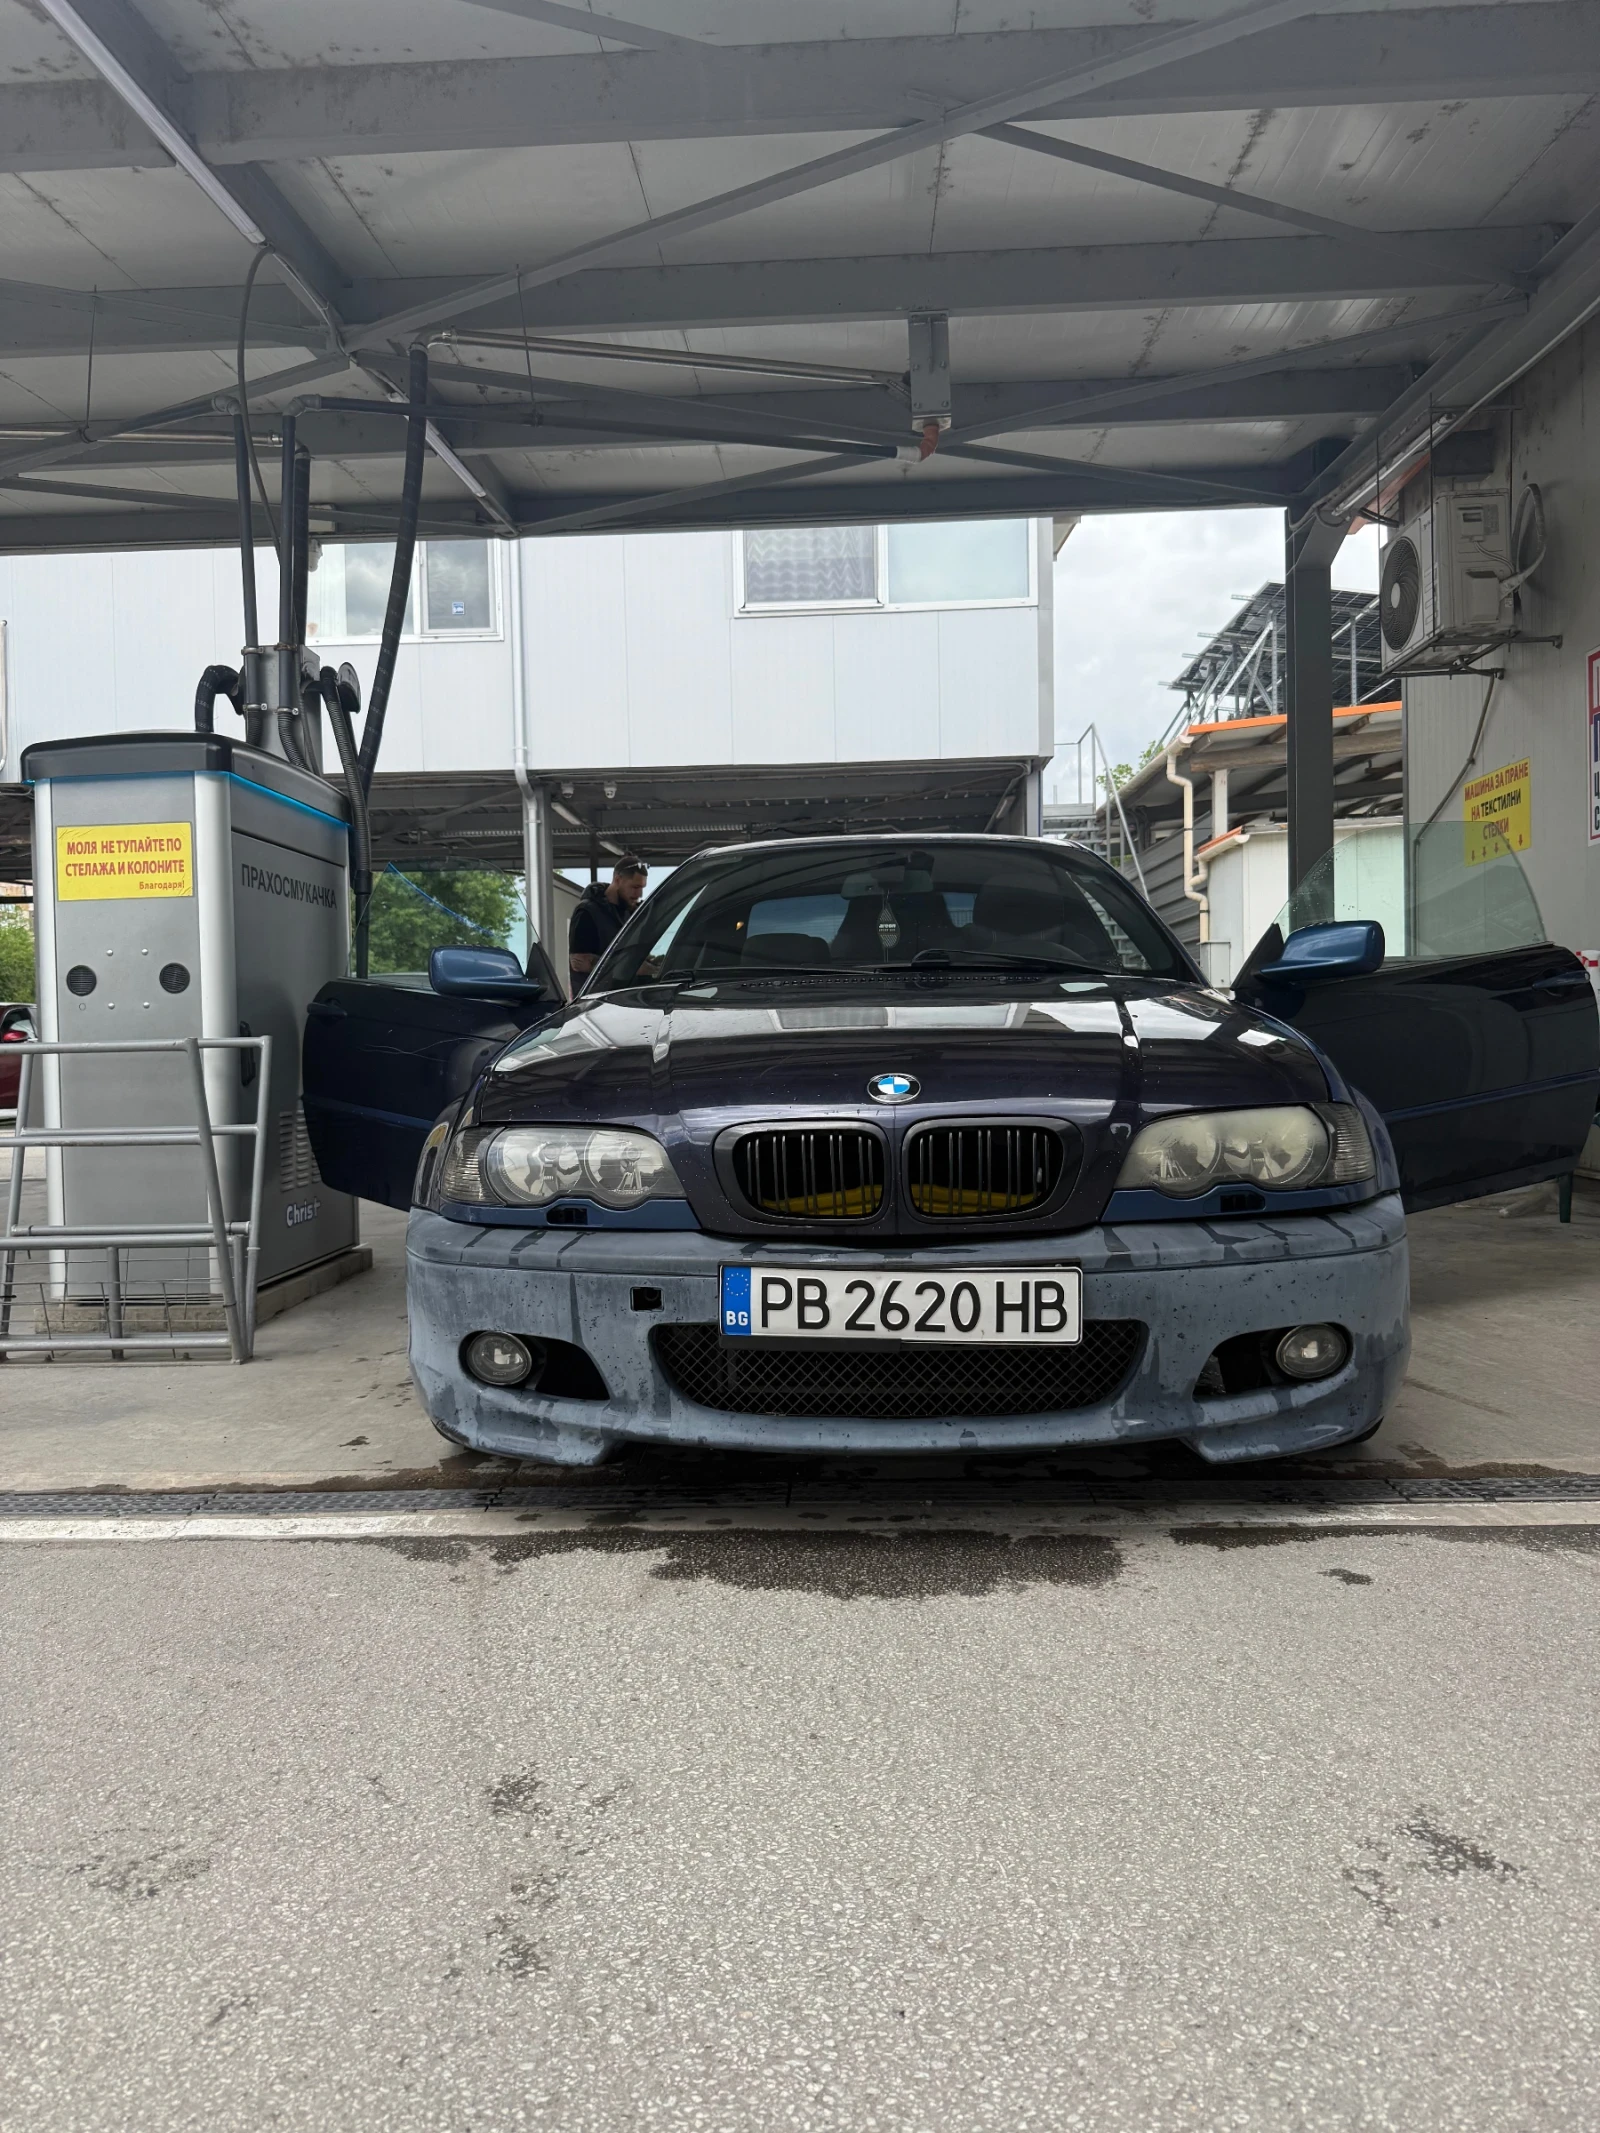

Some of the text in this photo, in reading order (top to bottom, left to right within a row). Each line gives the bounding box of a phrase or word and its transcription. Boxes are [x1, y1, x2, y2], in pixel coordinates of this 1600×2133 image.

[1464, 762, 1529, 801] МАШИНА ЗА ПРАНЕ
[1471, 788, 1522, 822] НА ТЕКСТИЛНИ
[66, 836, 182, 855] МОЛЯ НЕ ТУПАЙТЕ ПО
[65, 860, 185, 877] СТЕЛАЖА И КОЛОНИТЕ
[139, 880, 185, 890] Благодаря!
[241, 863, 338, 910] ПРАХОСМУКАЧКА
[286, 1197, 321, 1227] Christ
[726, 1310, 749, 1326] BG
[761, 1276, 1068, 1333] PB 2620 HB
